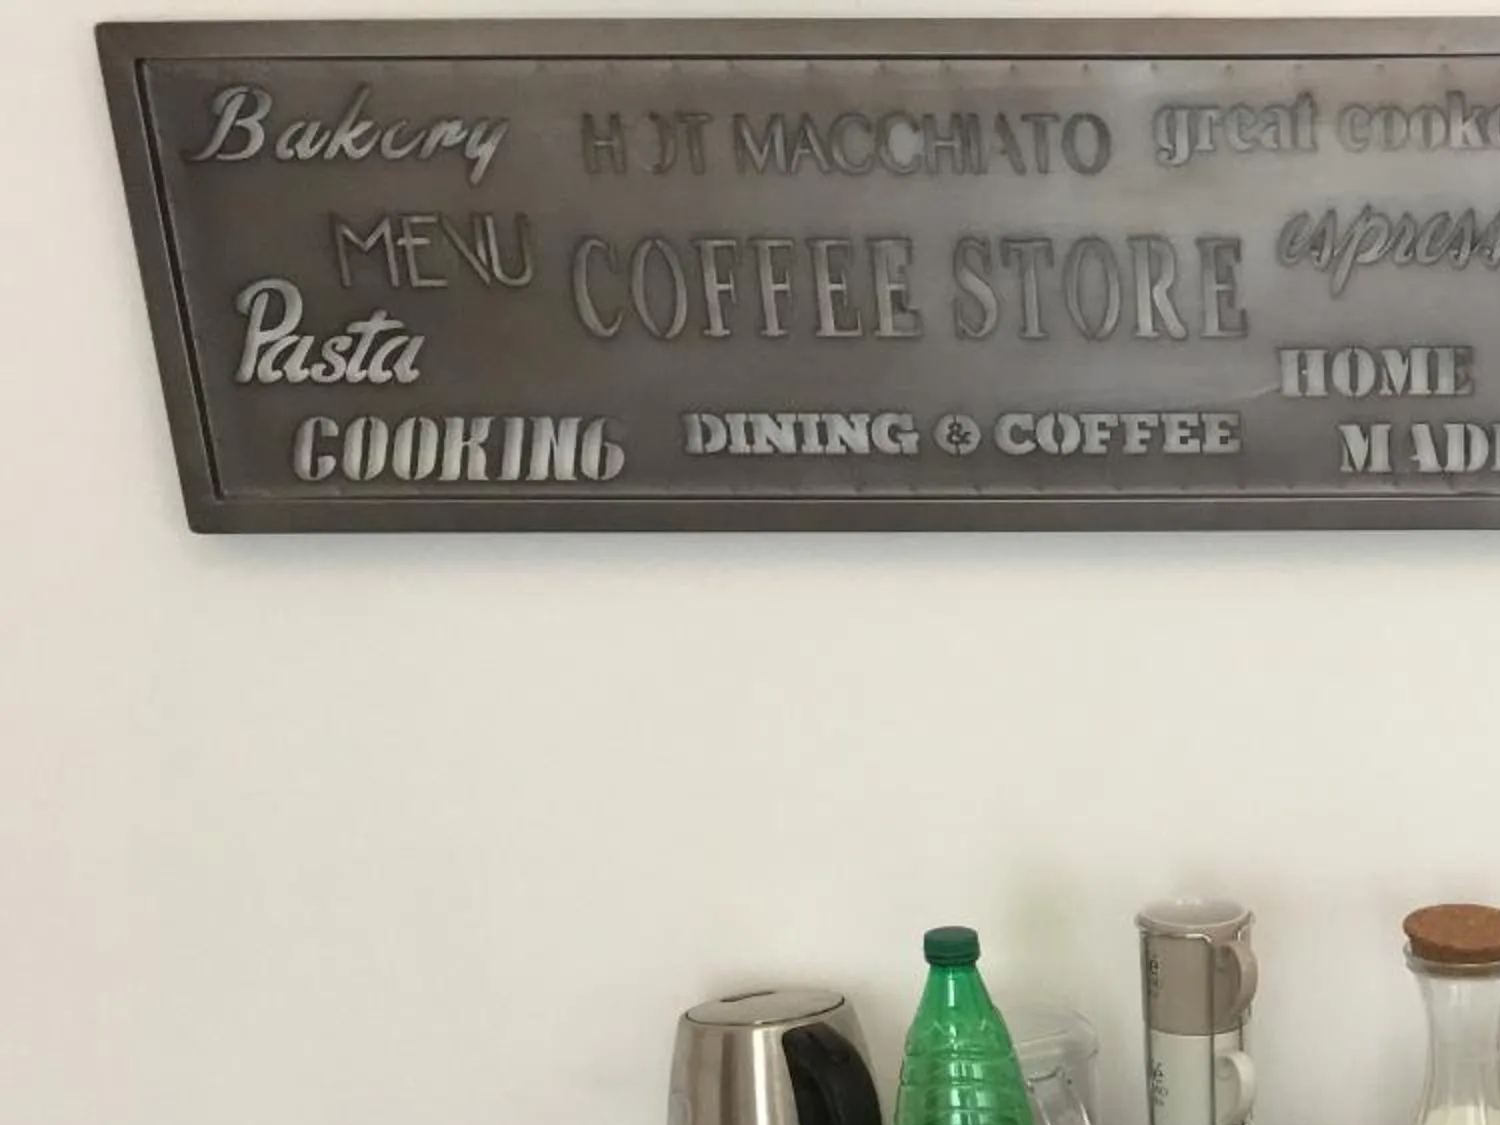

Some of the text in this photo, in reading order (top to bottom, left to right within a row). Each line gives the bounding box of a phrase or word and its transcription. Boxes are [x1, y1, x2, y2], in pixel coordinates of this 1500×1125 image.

[580, 111, 1112, 177] HOT MACCHIATO
[1152, 91, 1319, 168] great
[330, 211, 535, 289] MENU
[571, 235, 1250, 342] COFFEE STORE
[234, 277, 426, 384] Pasta
[1276, 344, 1476, 400] HOME
[293, 414, 627, 482] COOKING
[683, 411, 921, 456] DINING
[994, 411, 1243, 456] COFFEE
